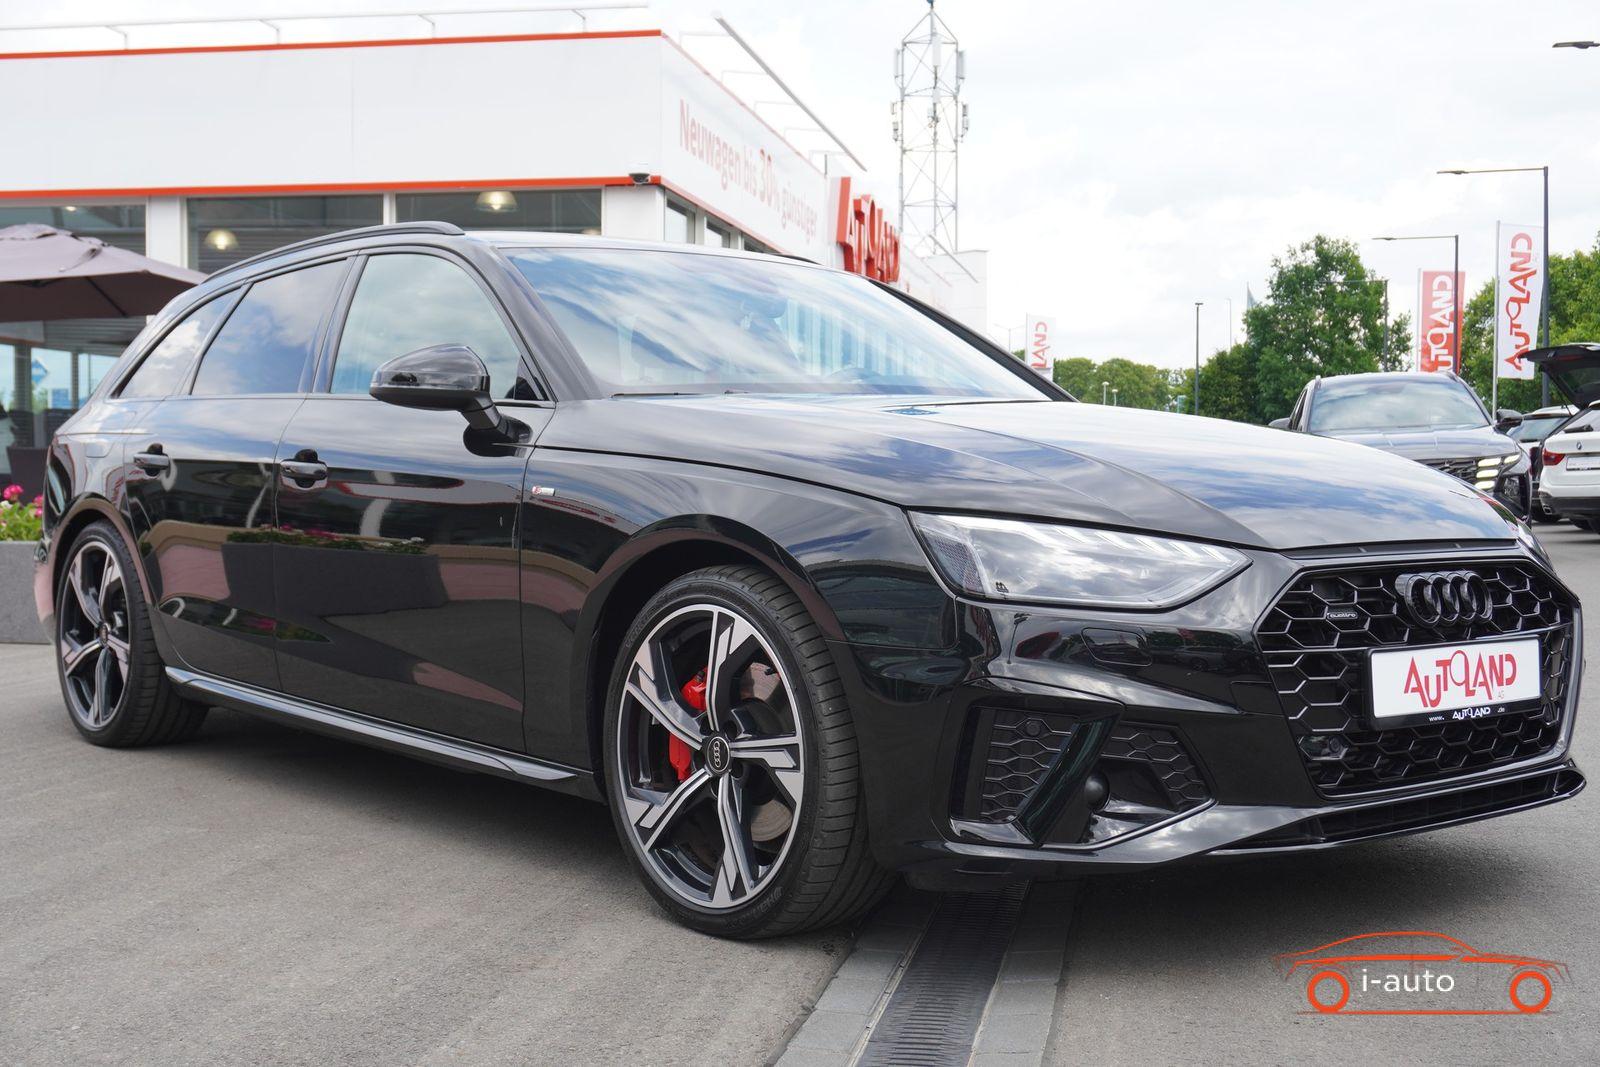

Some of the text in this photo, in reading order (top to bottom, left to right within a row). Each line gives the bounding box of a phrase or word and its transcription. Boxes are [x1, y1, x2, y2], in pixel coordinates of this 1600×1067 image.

[679, 98, 741, 190] Neuwagen
[743, 144, 757, 197] bis
[1426, 274, 1455, 372] UTOLAND
[1503, 232, 1537, 371] AUTOLAND
[1031, 321, 1051, 368] LAND
[1403, 649, 1517, 708] AUTOLAND
[1452, 707, 1491, 721] AUTOLAND
